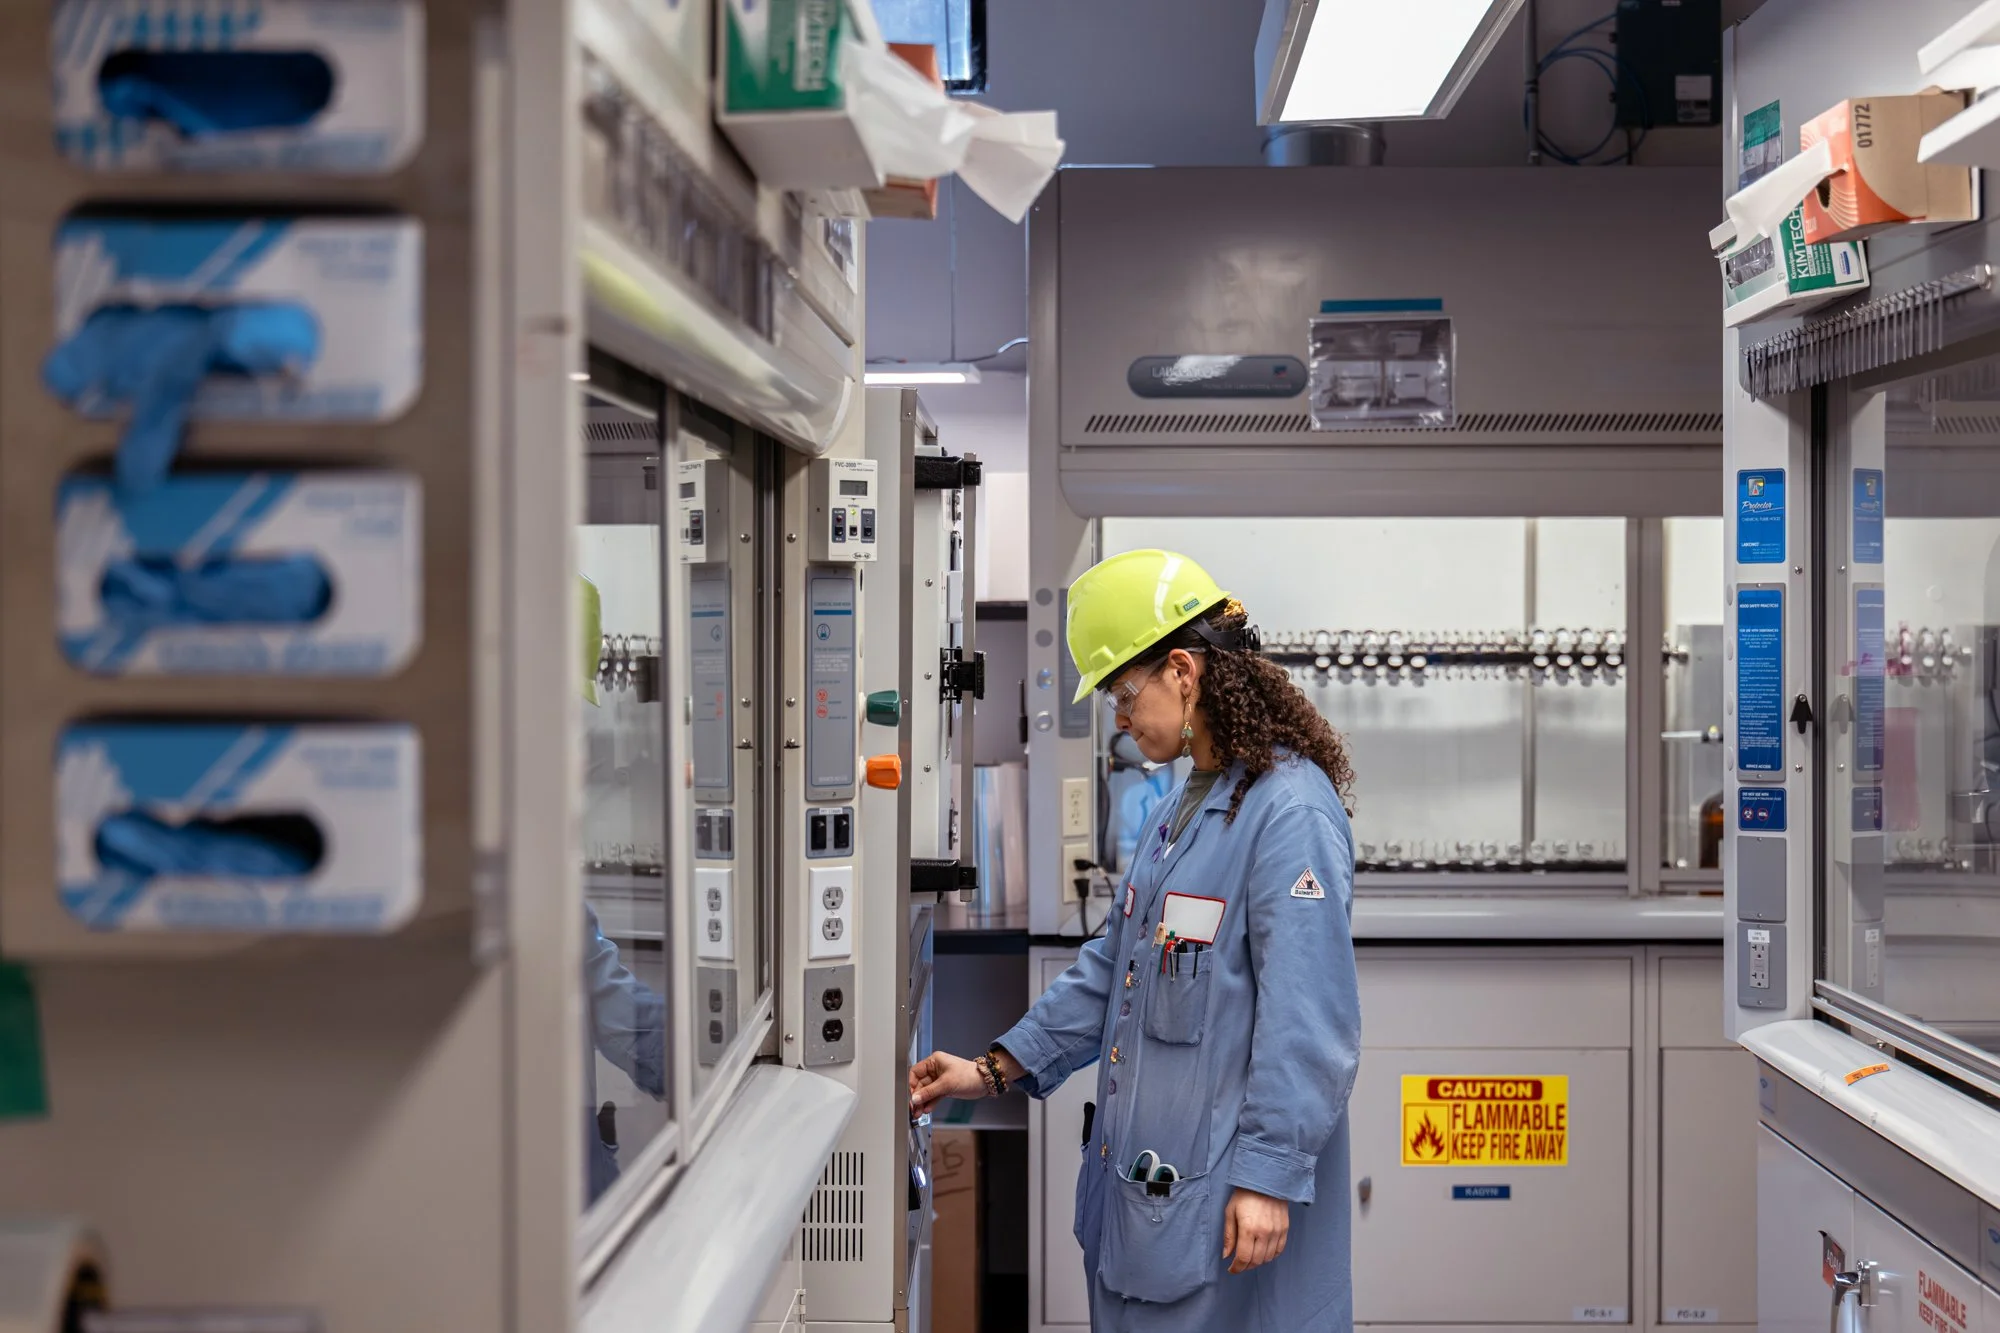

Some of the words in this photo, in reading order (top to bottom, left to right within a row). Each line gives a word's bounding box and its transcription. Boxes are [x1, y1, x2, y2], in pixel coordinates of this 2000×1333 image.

[1855, 103, 1872, 148] 01772
[1788, 207, 1809, 278] KIMTECH
[1437, 1081, 1532, 1098] CAUTION
[1452, 1103, 1565, 1130] FLAMMABLE
[1451, 1133, 1486, 1160] KEEP
[1491, 1133, 1520, 1160] FIRE
[1524, 1133, 1564, 1161] AWAY
[1919, 1270, 1966, 1329] FLAMMABLE
[1919, 1300, 1933, 1326] KEEP
